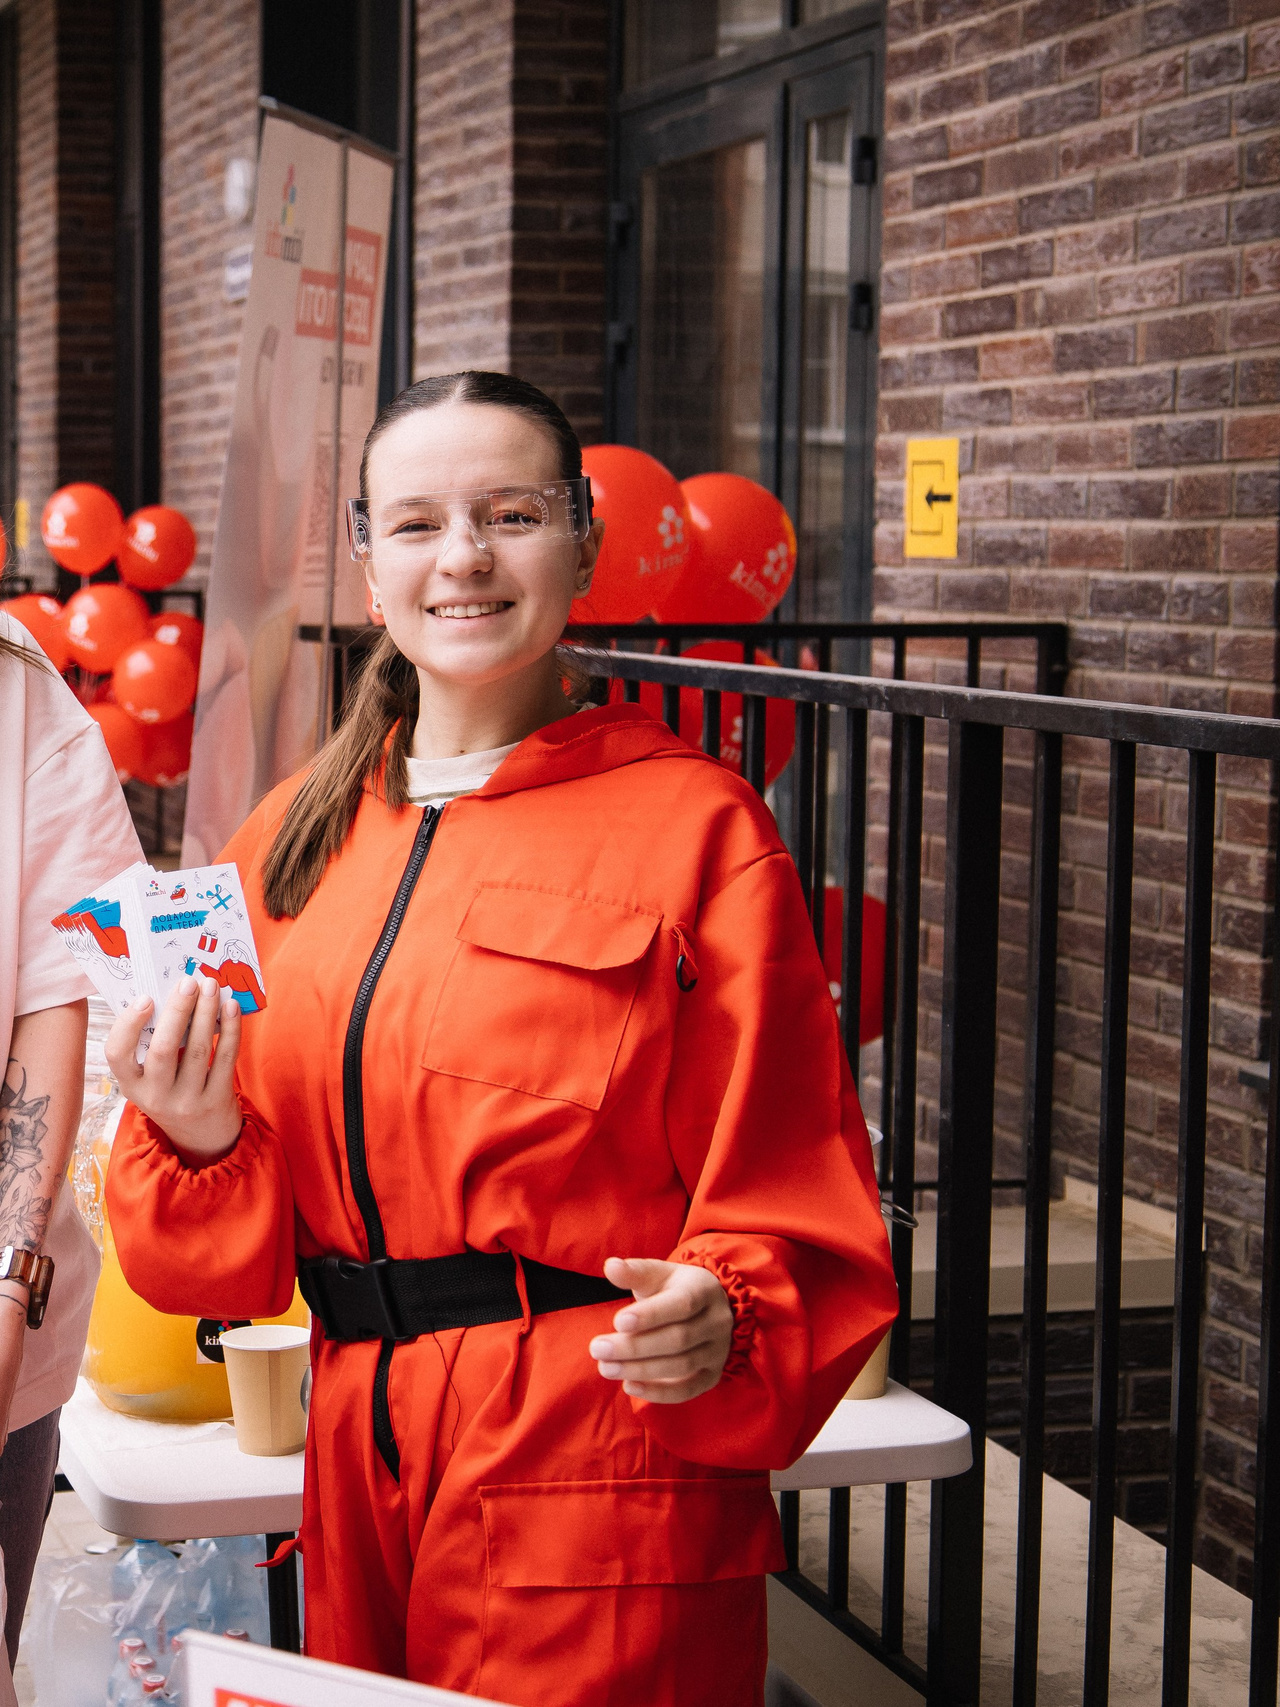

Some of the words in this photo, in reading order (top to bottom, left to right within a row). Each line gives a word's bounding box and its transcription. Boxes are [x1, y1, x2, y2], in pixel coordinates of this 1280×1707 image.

[145, 889, 167, 897] kimchi
[152, 910, 197, 923] ПОДАРОК
[154, 923, 173, 934] ДЛЯ
